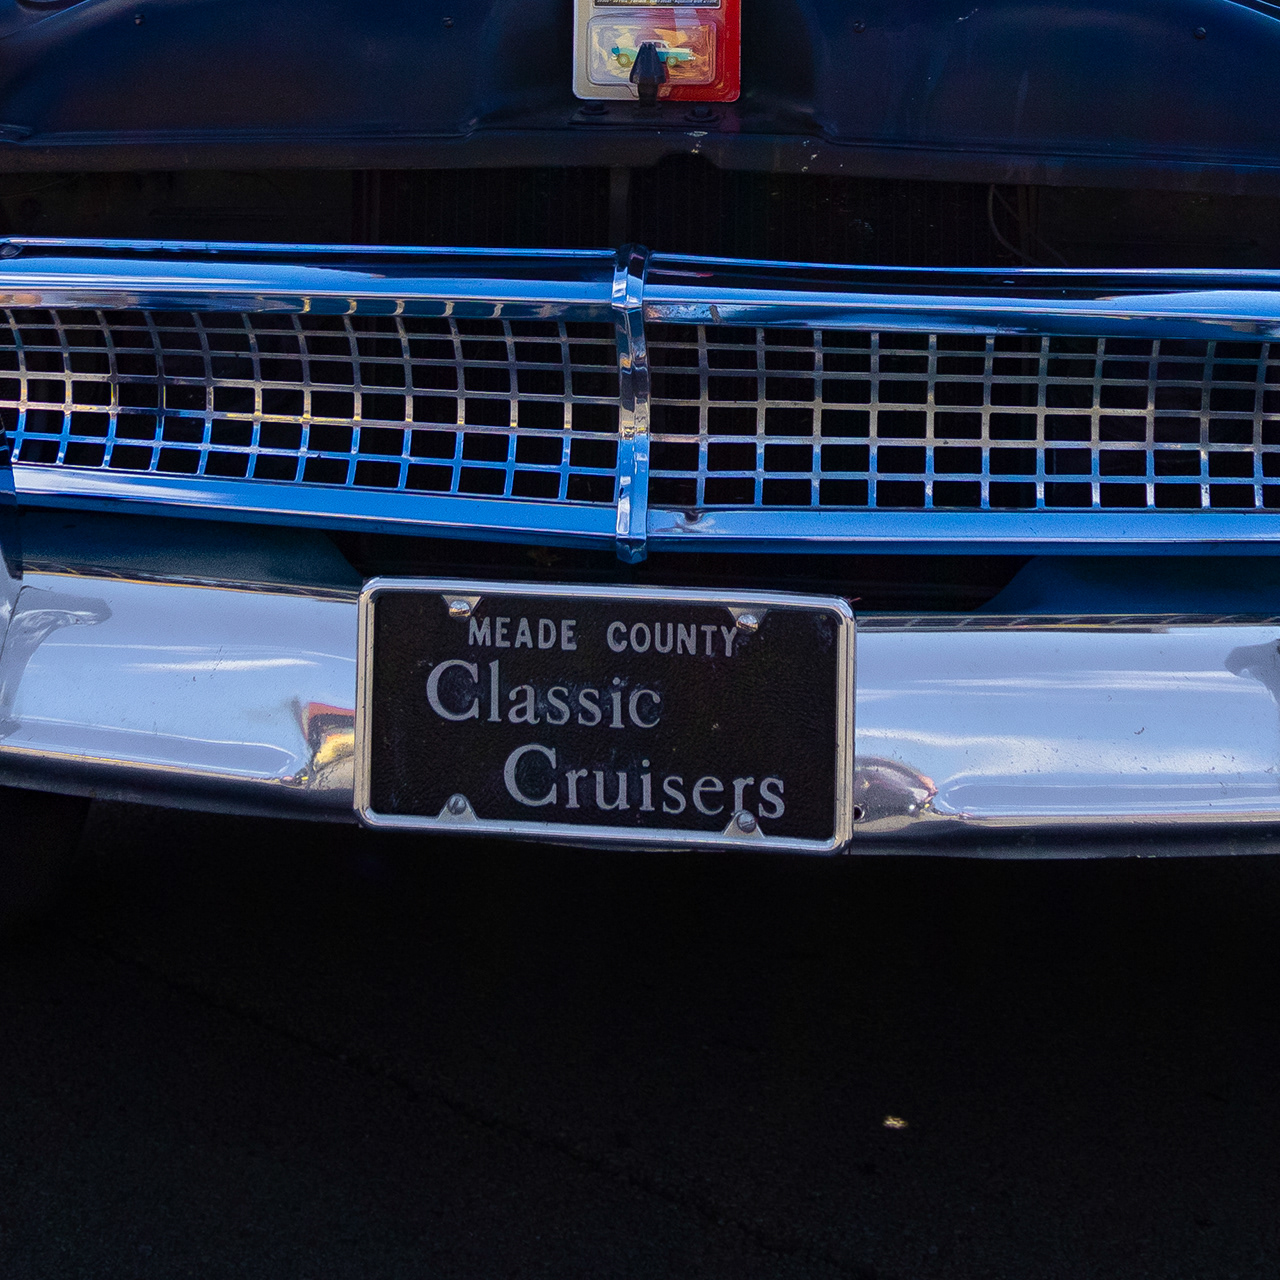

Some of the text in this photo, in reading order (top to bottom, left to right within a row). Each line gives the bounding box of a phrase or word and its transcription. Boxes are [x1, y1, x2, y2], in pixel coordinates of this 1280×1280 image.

[467, 617, 739, 657] MEADE COUNTY
[425, 659, 662, 728] Classic
[503, 744, 786, 819] Cruisers
